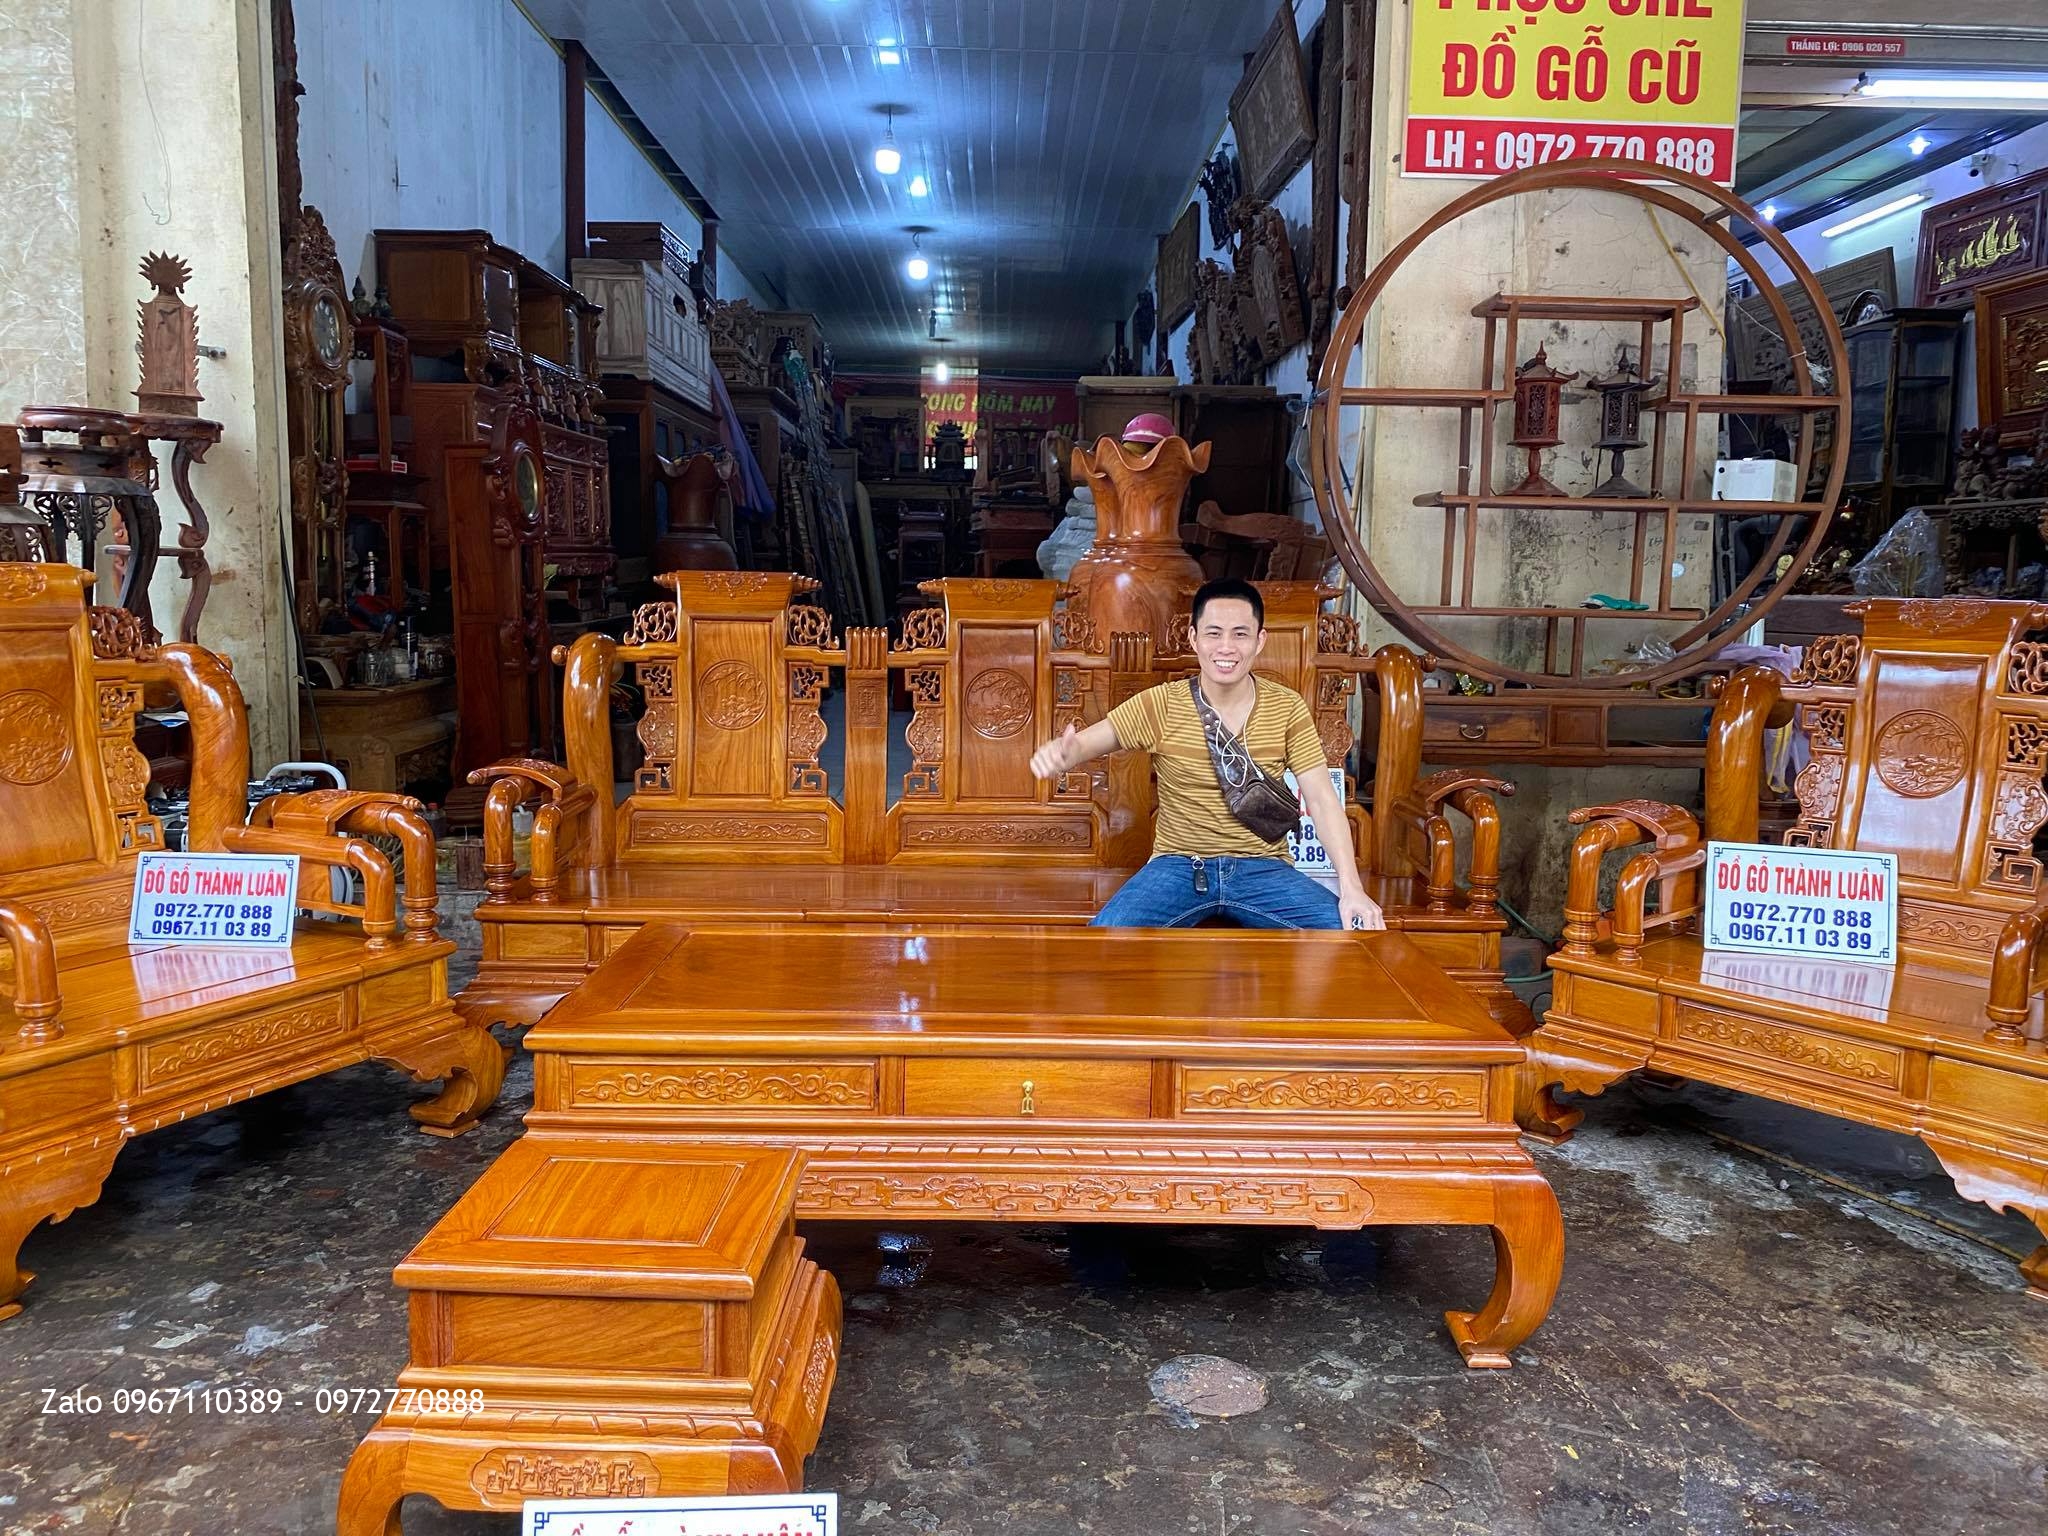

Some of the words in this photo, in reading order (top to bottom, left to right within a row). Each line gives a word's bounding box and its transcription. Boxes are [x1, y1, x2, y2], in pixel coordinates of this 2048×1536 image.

[1442, 26, 1517, 99] ĐỒ
[1536, 25, 1608, 102] GỖ
[1628, 39, 1701, 104] CŨ
[1495, 132, 1576, 169] 0972
[1656, 137, 1715, 176] 888
[1020, 396, 1057, 412] NAY
[144, 864, 166, 893] ĐỒ
[169, 863, 191, 894] GỖ
[196, 867, 243, 895] THÀNH
[247, 868, 287, 896] LUÂN
[1718, 855, 1741, 890] ĐỒ
[1746, 856, 1769, 892] GỖ
[1776, 862, 1832, 897] THÀNH
[1838, 867, 1884, 901] LUÂN
[154, 903, 234, 918] 0972.770
[240, 905, 272, 919] 888
[1729, 902, 1825, 925] 0972.770
[1832, 910, 1872, 928] 888
[152, 920, 217, 935] 0967.11
[225, 922, 245, 936] 03
[250, 923, 271, 937] 89
[1729, 922, 1805, 945] 0967.11
[1815, 930, 1840, 947] 03
[1847, 932, 1872, 949] 89
